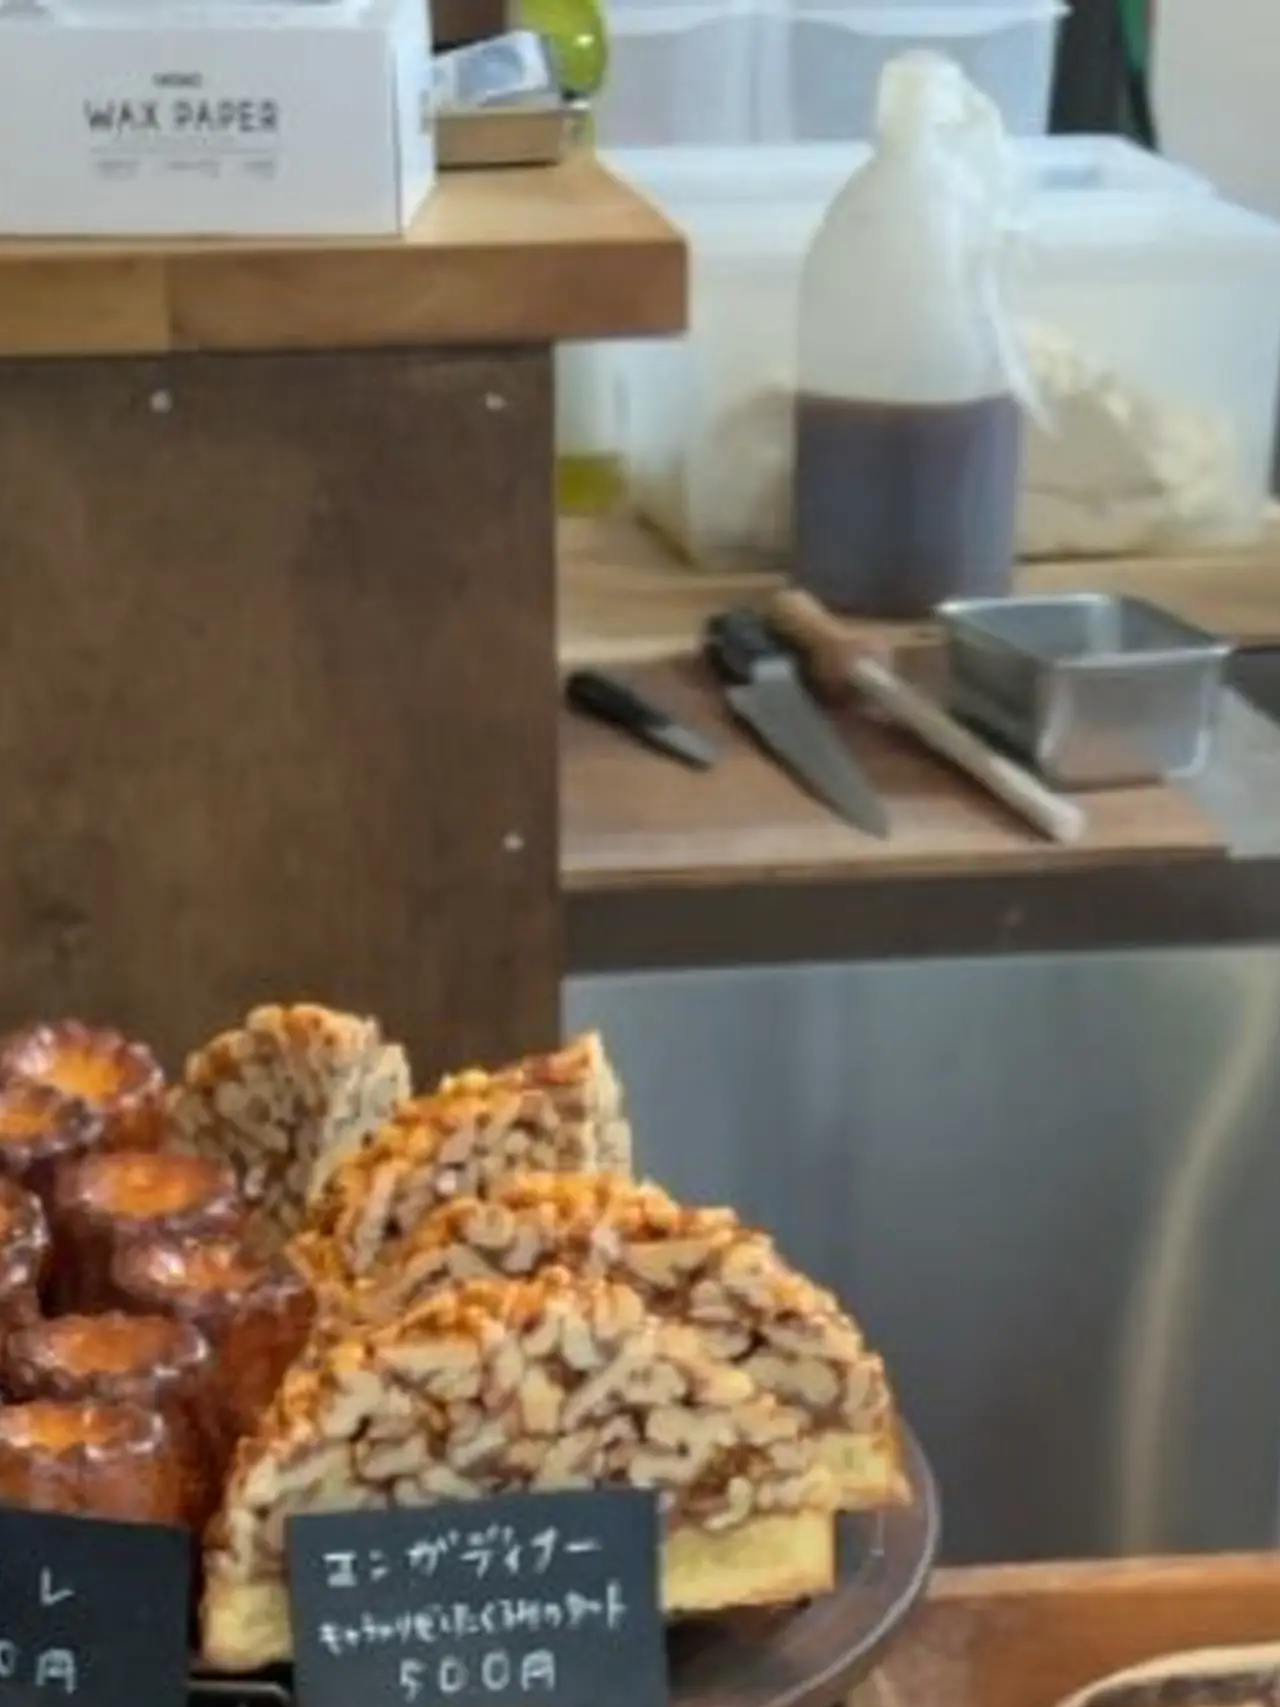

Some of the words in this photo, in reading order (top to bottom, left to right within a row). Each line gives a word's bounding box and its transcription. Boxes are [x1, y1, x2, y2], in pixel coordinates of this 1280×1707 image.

[84, 100, 161, 132] WAX
[175, 101, 280, 134] PAPER
[398, 1648, 557, 1702] 500円
